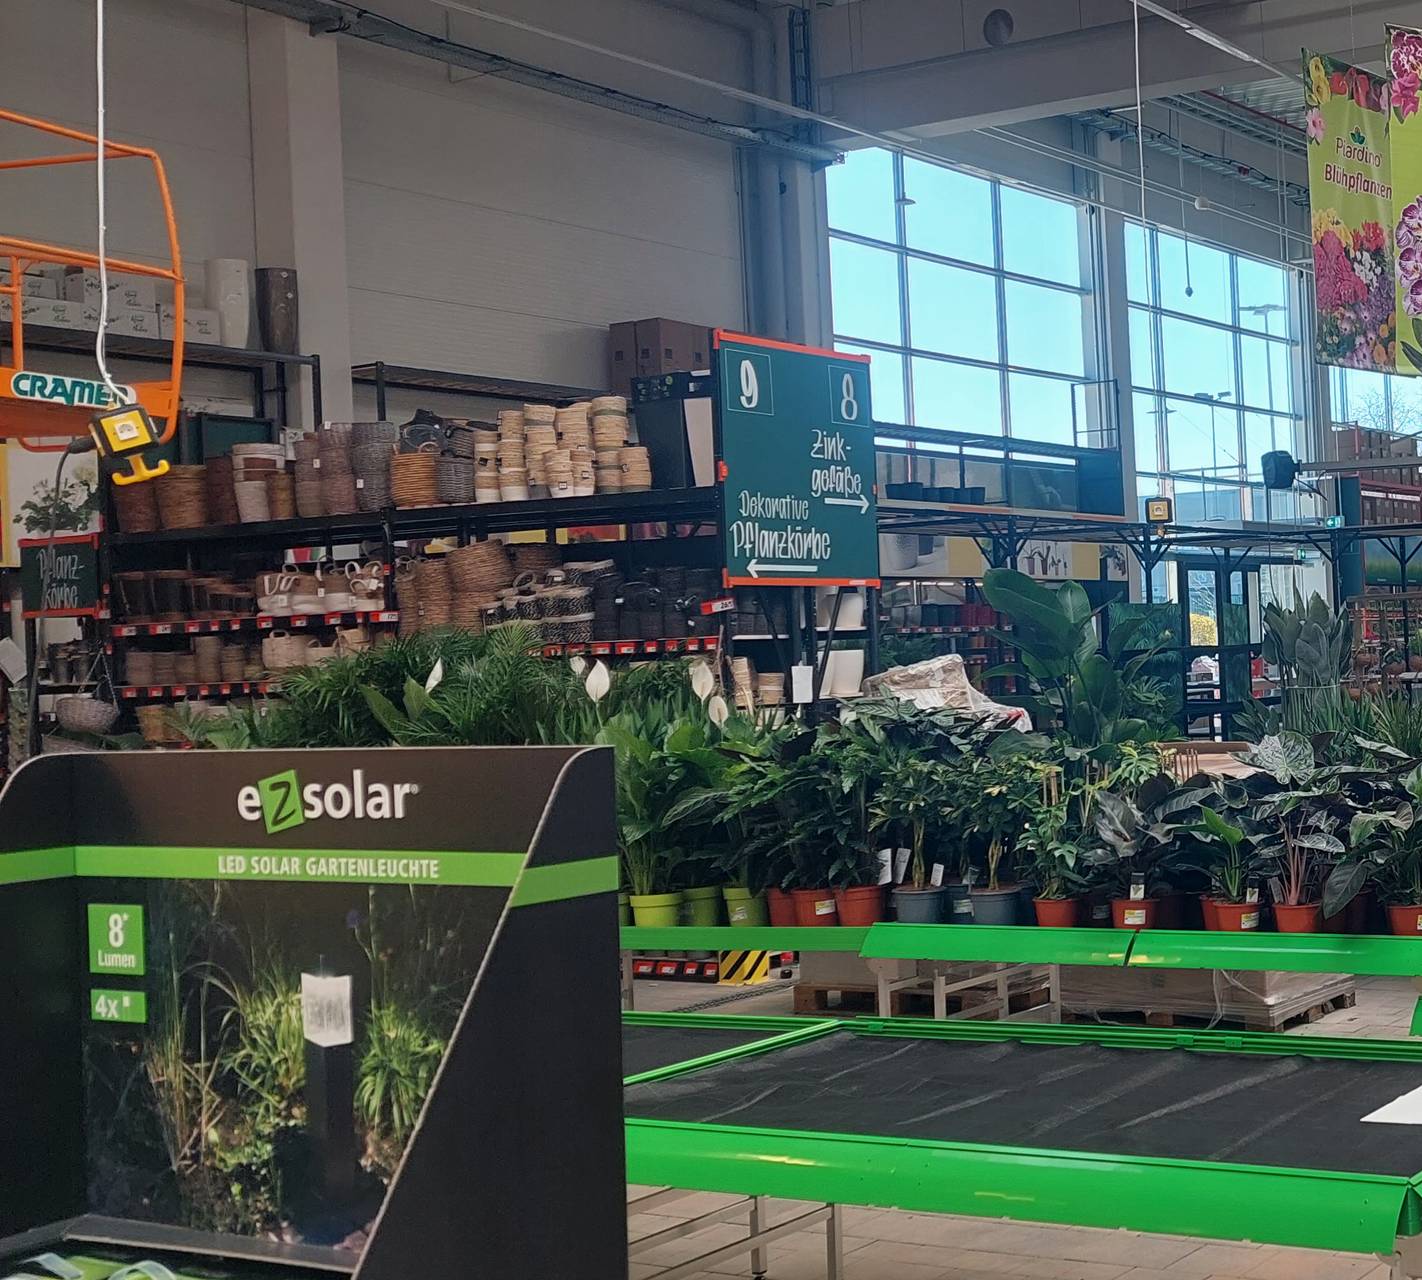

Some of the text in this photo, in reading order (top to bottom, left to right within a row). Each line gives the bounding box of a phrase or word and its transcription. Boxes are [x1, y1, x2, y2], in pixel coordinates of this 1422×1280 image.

[1324, 163, 1393, 200] Blühpflanzen
[740, 359, 858, 421] 9 8
[810, 429, 852, 461] Zink-
[811, 465, 862, 497] gefäße
[738, 490, 809, 520] Dekorative
[729, 520, 831, 560] Pflanzkörbe
[218, 855, 440, 878] LED SOLAR GARTENLEUCHTE
[98, 949, 136, 968] Lumen
[95, 994, 119, 1018] 4x
